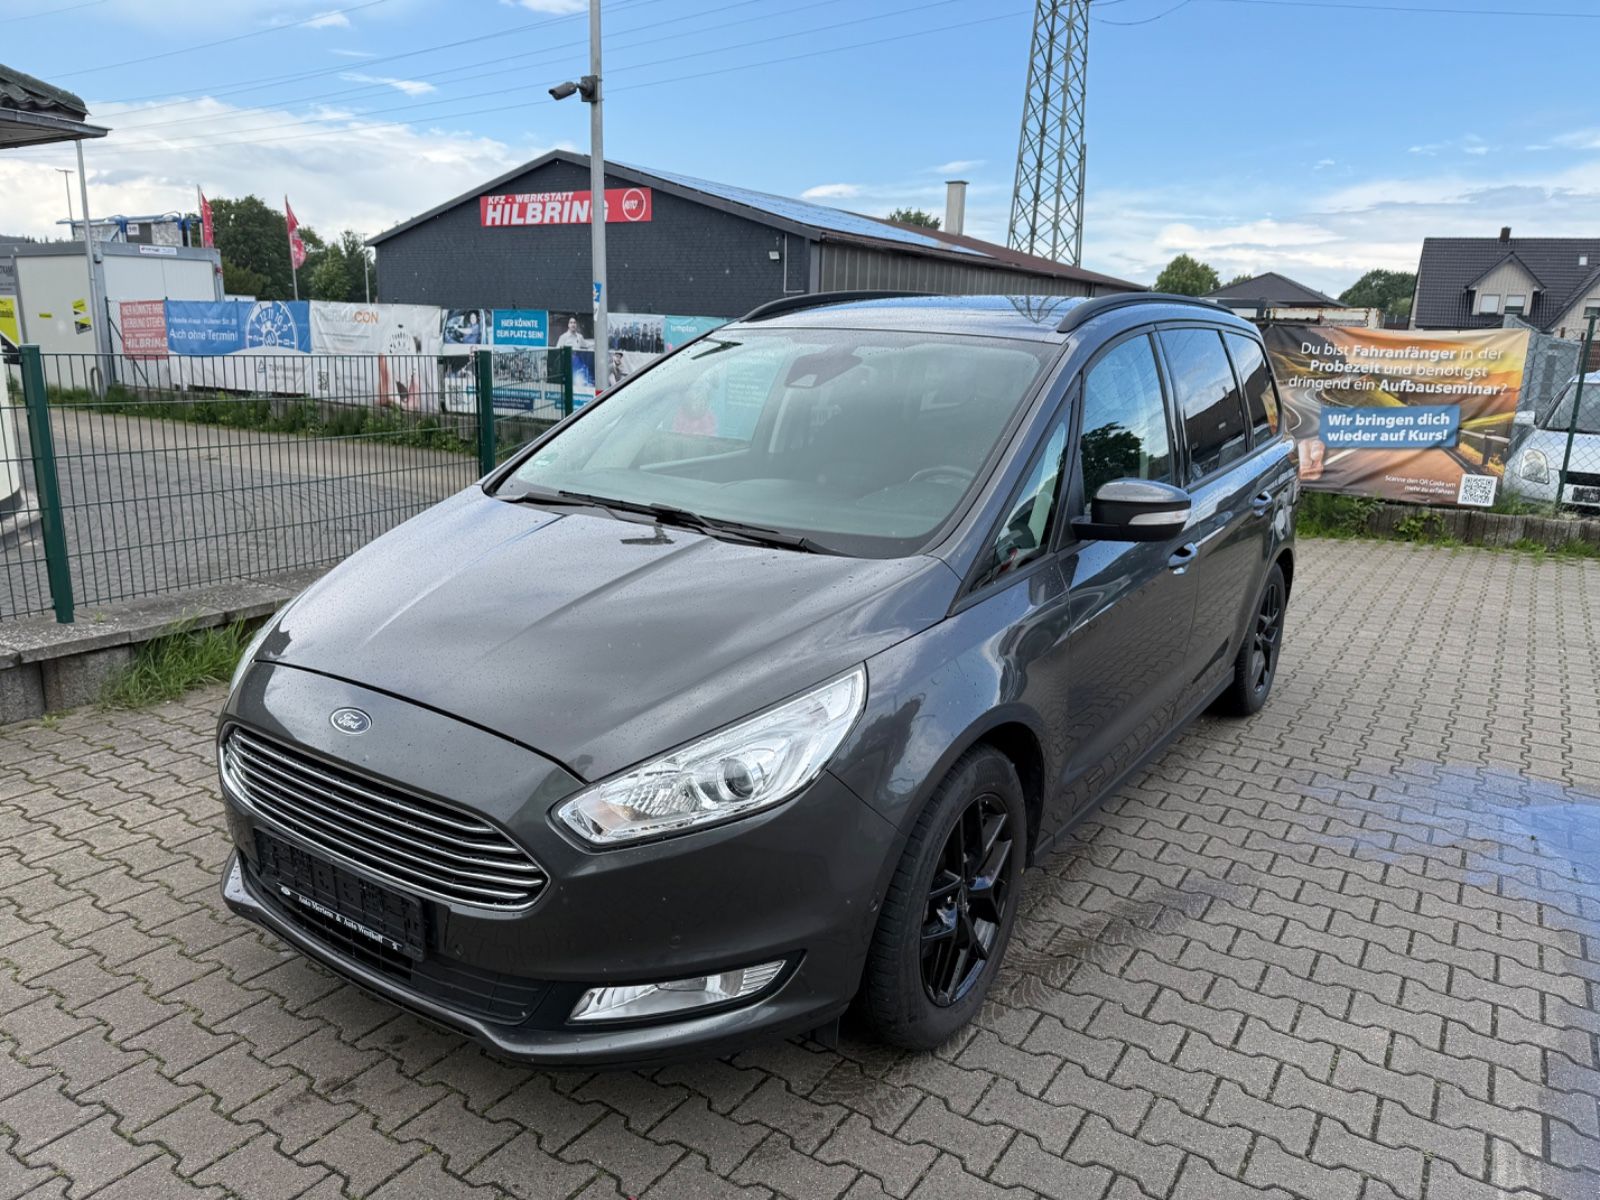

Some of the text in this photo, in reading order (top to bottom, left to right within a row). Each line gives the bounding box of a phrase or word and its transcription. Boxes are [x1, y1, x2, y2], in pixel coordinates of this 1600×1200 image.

[488, 196, 505, 205] KFZ
[515, 192, 574, 204] WERKSTATT
[170, 328, 187, 339] Auch
[188, 329, 206, 341] ohne
[1301, 342, 1505, 362] Du bist Fahranfänger in der
[1310, 359, 1489, 380] Probezeit und benötigst
[1288, 375, 1508, 396] dringend ein Aufbauseminar?
[1328, 412, 1450, 429] Wir bringen dich
[1327, 429, 1449, 441] wieder auf Kurs!
[338, 712, 362, 729] Ford
[299, 895, 311, 908] Auto
[344, 918, 357, 931] Auto
